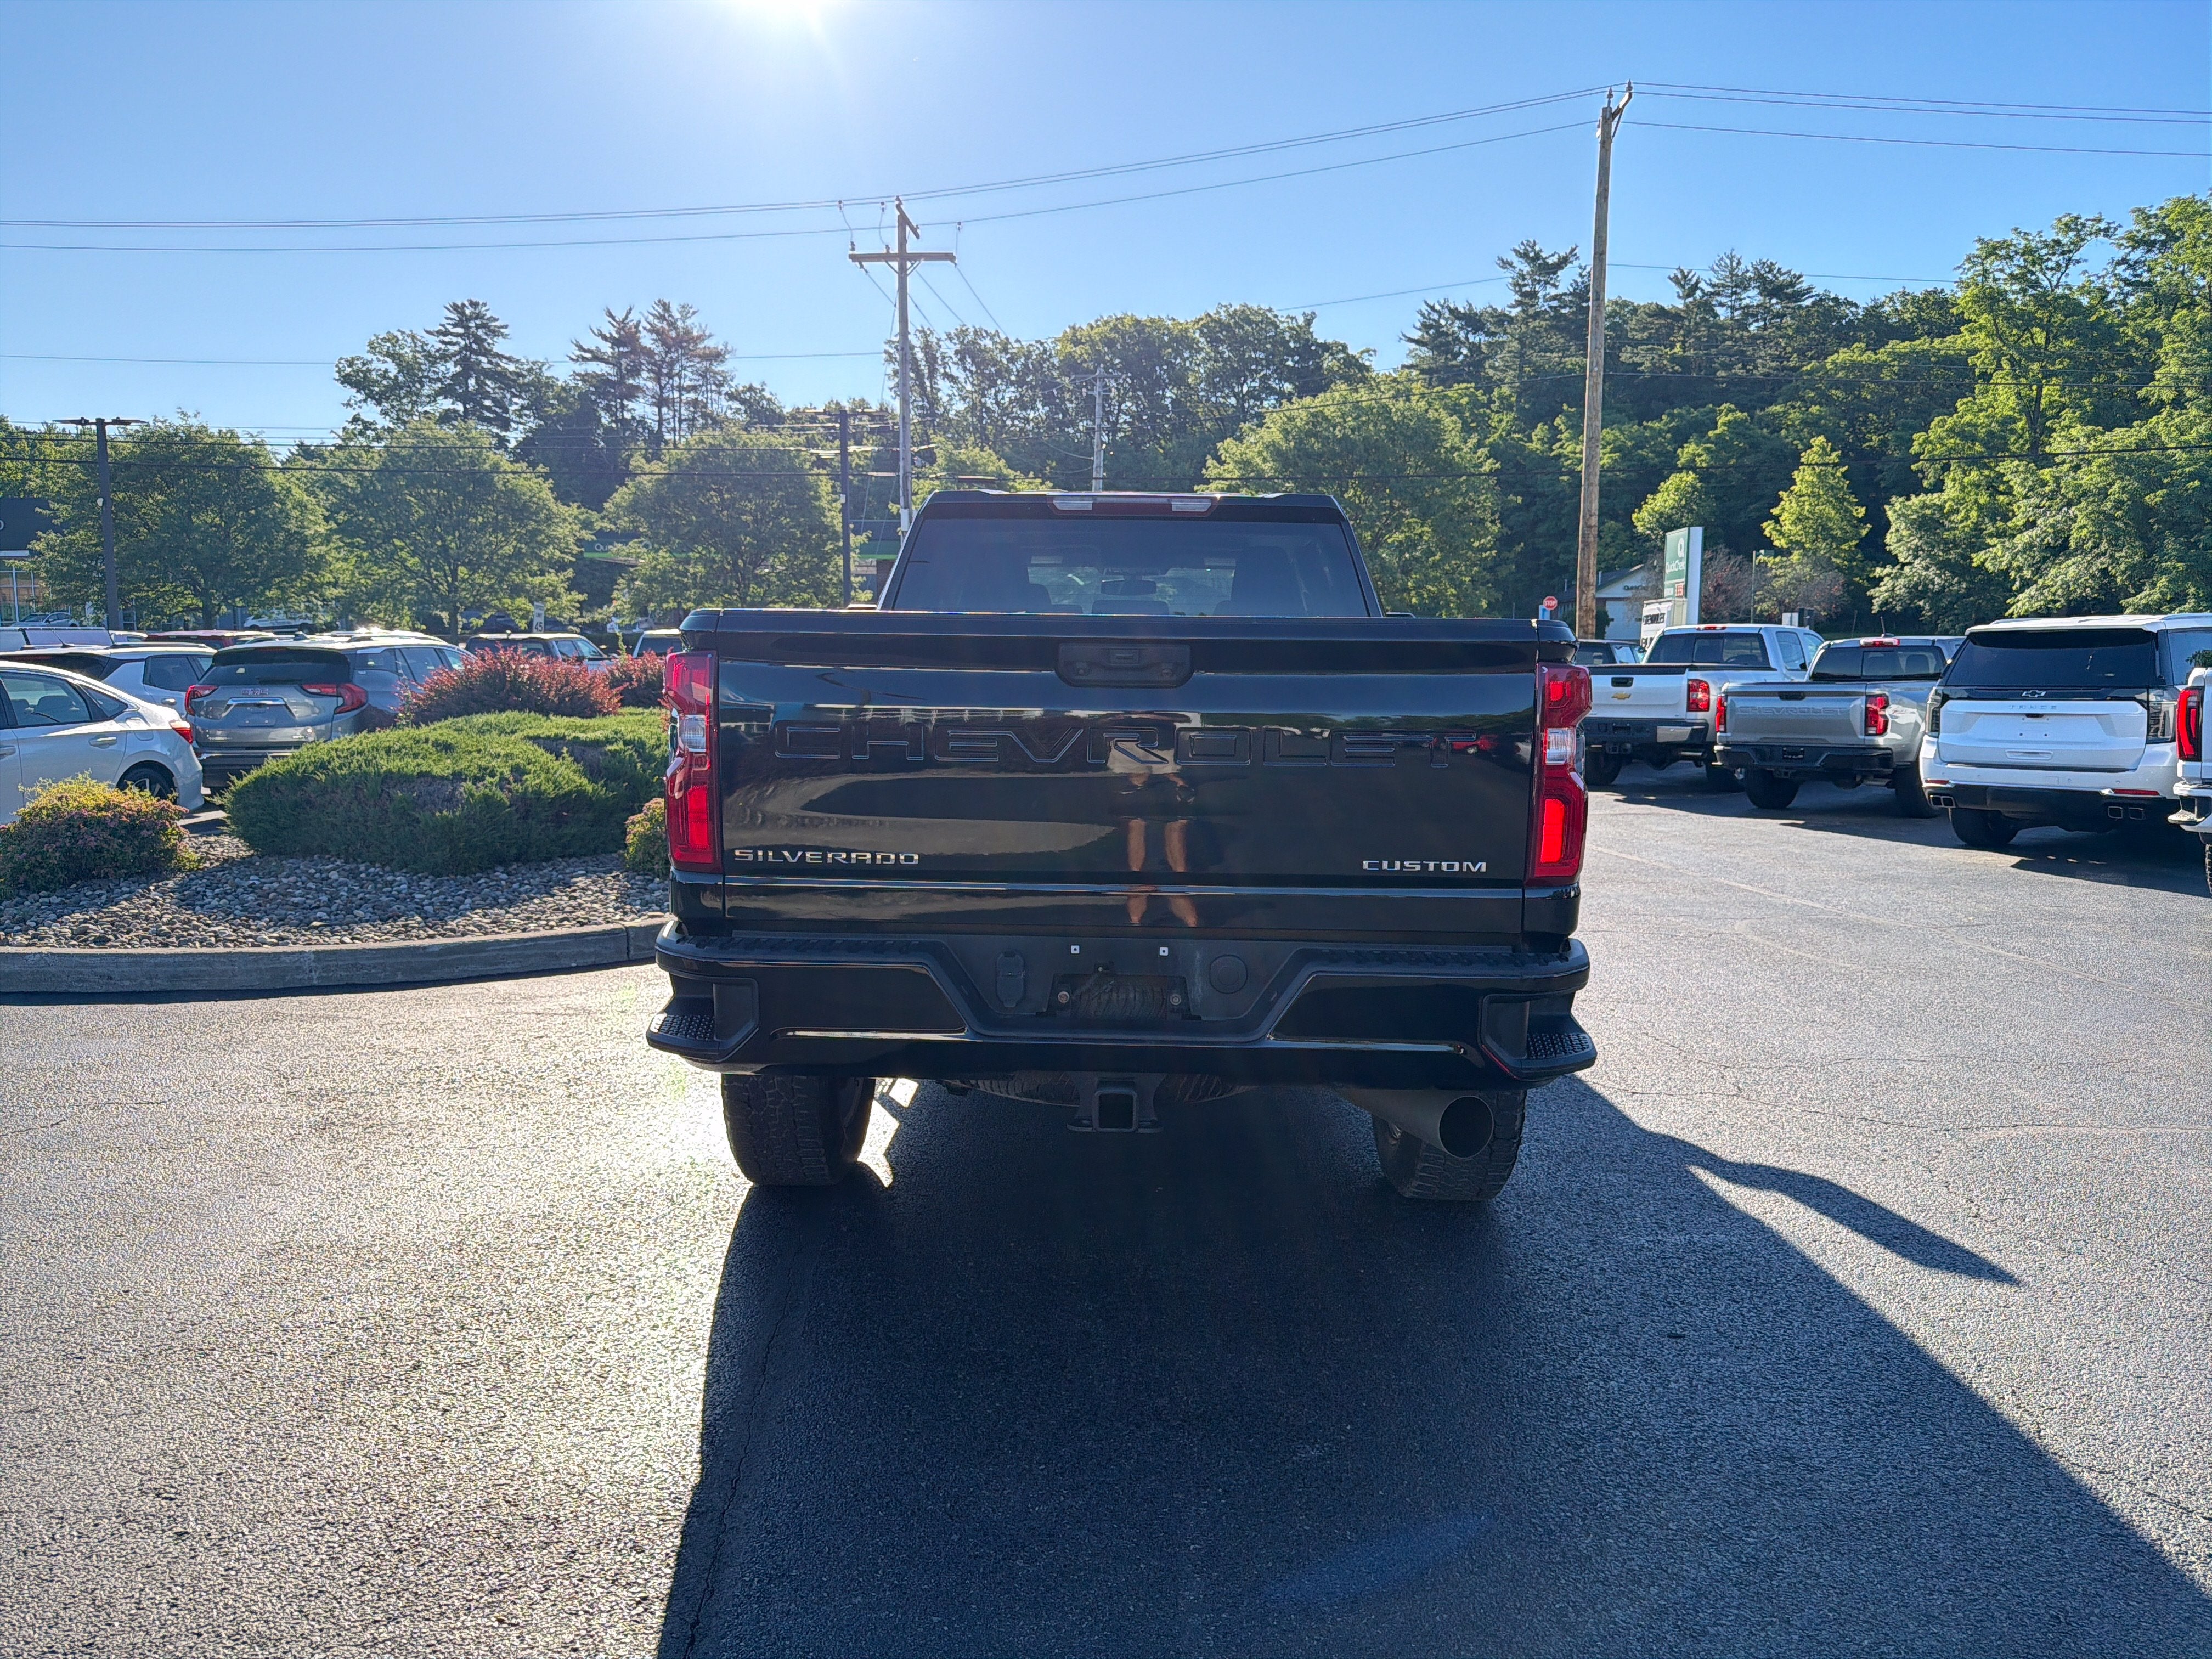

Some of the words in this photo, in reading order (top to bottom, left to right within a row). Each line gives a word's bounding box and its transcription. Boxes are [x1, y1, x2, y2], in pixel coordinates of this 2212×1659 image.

[535, 622, 543, 632] 45
[1738, 706, 1847, 715] CHEVROLET
[775, 720, 1477, 768] CHEVROLET
[734, 850, 919, 865] SILVERADO
[1362, 860, 1487, 872] CUSTOM
